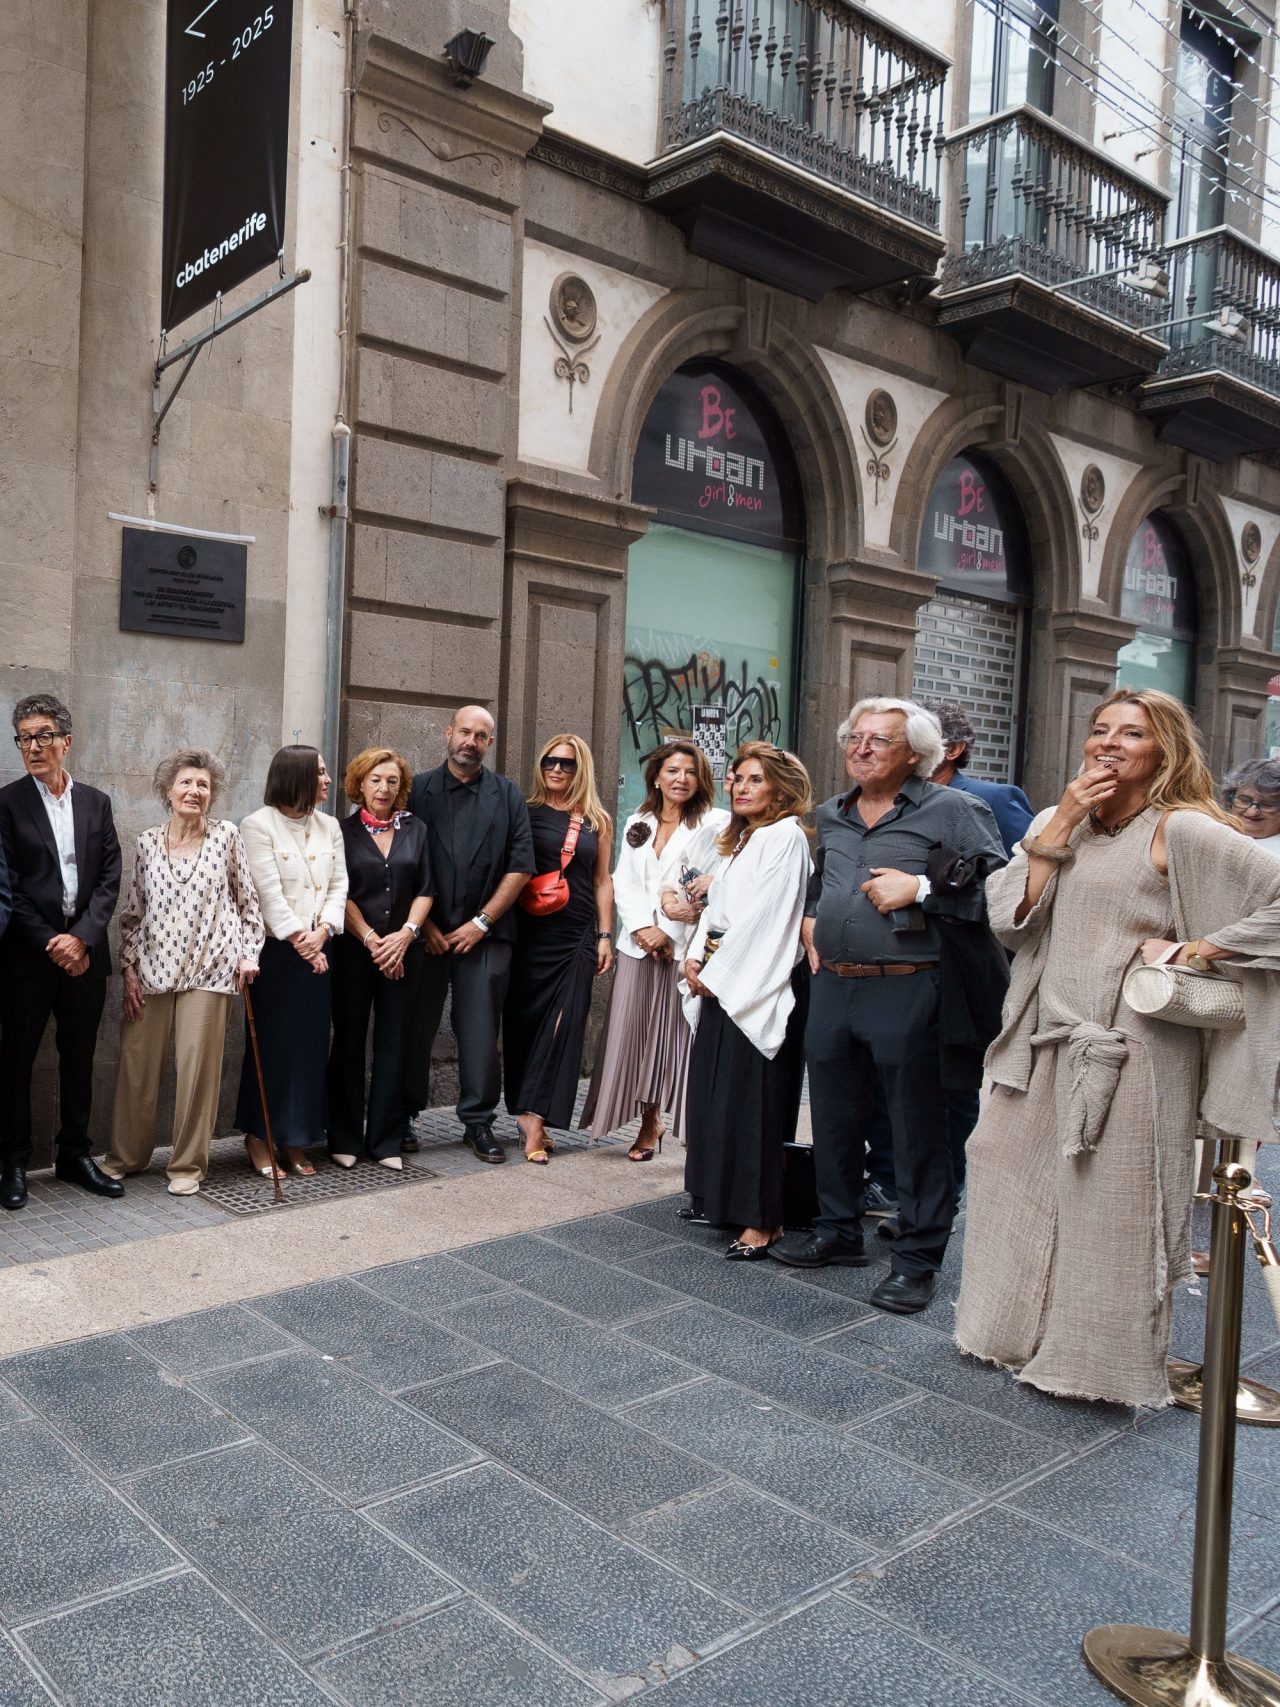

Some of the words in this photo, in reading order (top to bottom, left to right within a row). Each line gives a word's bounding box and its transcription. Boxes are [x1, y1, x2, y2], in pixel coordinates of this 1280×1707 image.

[182, 61, 215, 106] 1925
[232, 5, 274, 60] 2025
[176, 212, 267, 288] cbatenerife
[665, 433, 764, 490] urban
[699, 482, 725, 508] girl
[735, 493, 762, 511] men
[934, 511, 1004, 555] urban
